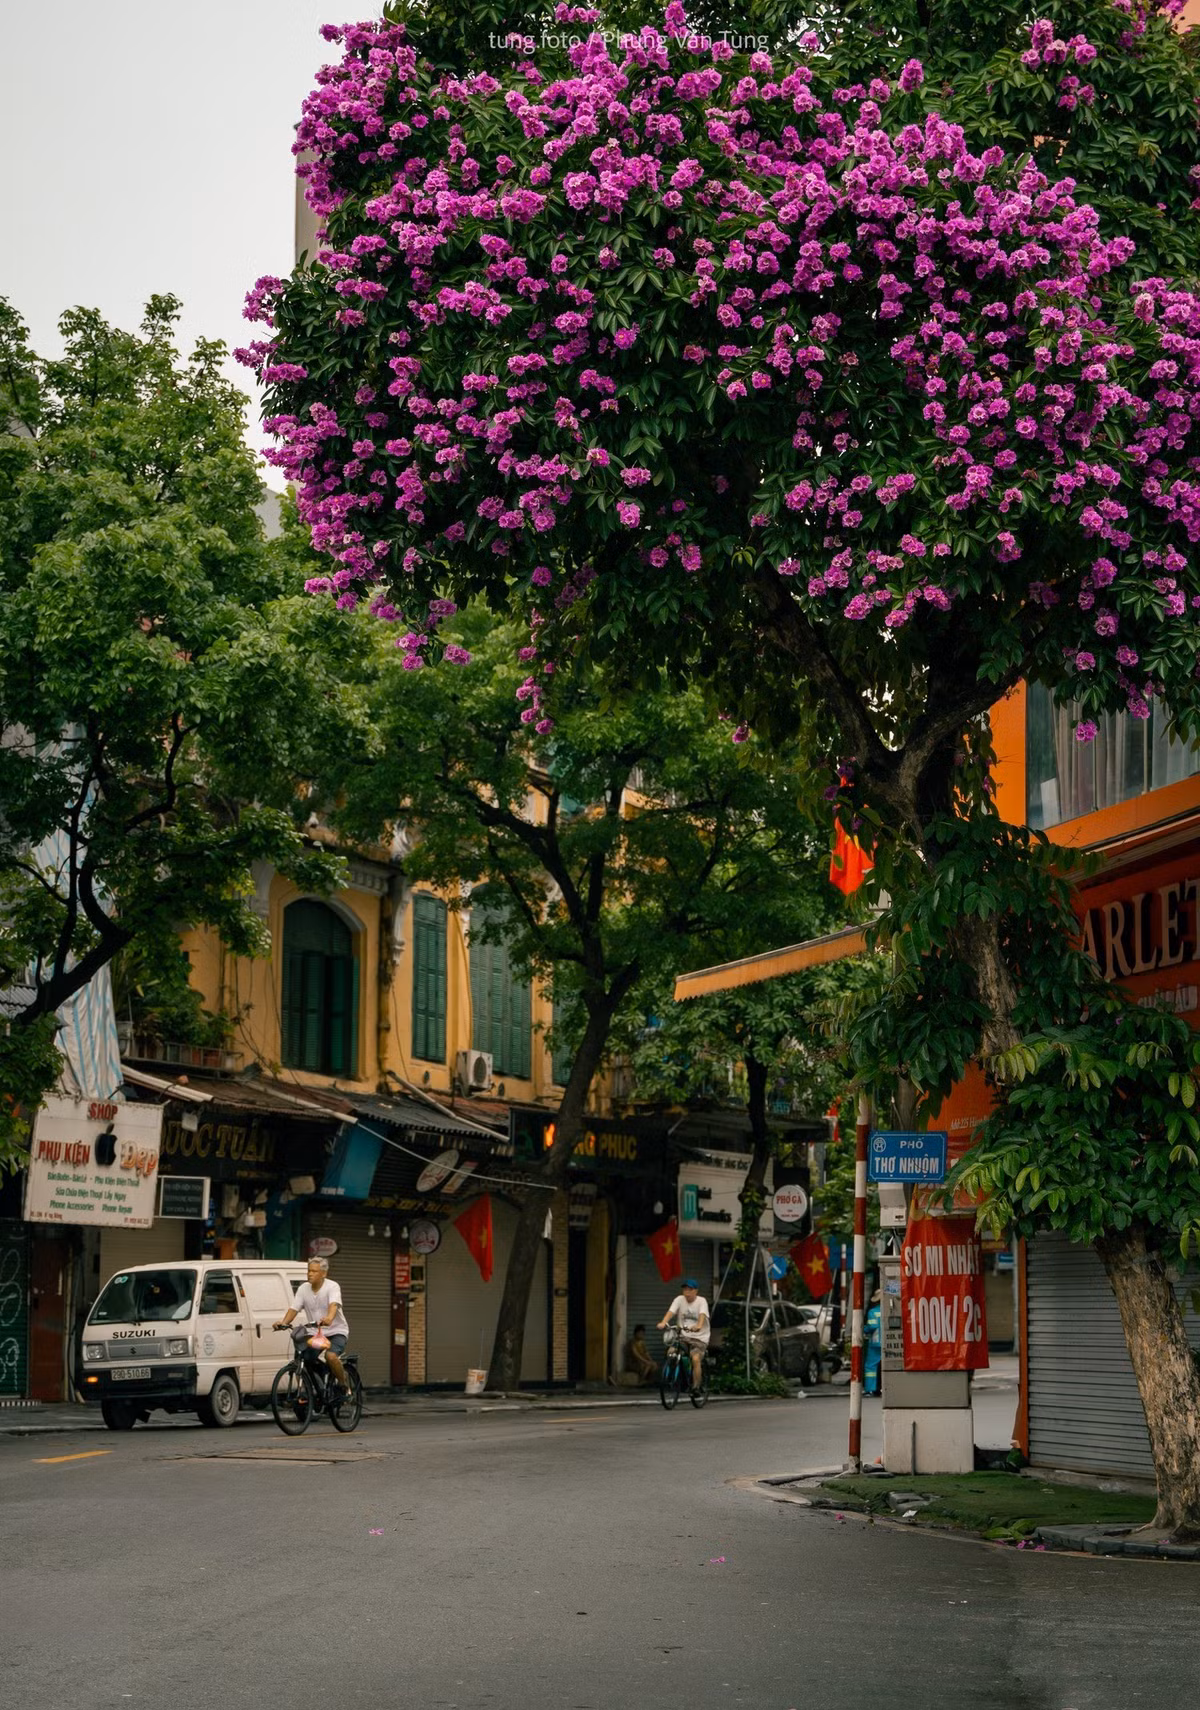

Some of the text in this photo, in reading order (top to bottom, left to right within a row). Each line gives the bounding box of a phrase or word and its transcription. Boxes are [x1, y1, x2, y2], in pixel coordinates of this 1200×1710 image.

[89, 1103, 118, 1120] SHOP
[900, 1137, 924, 1149] PHỐ
[120, 1141, 158, 1178] Đẹp
[874, 1153, 939, 1177] THỢ NHUỘM
[904, 1238, 980, 1282] SƠ MI NHẬT
[112, 1329, 156, 1339] SUZUKI
